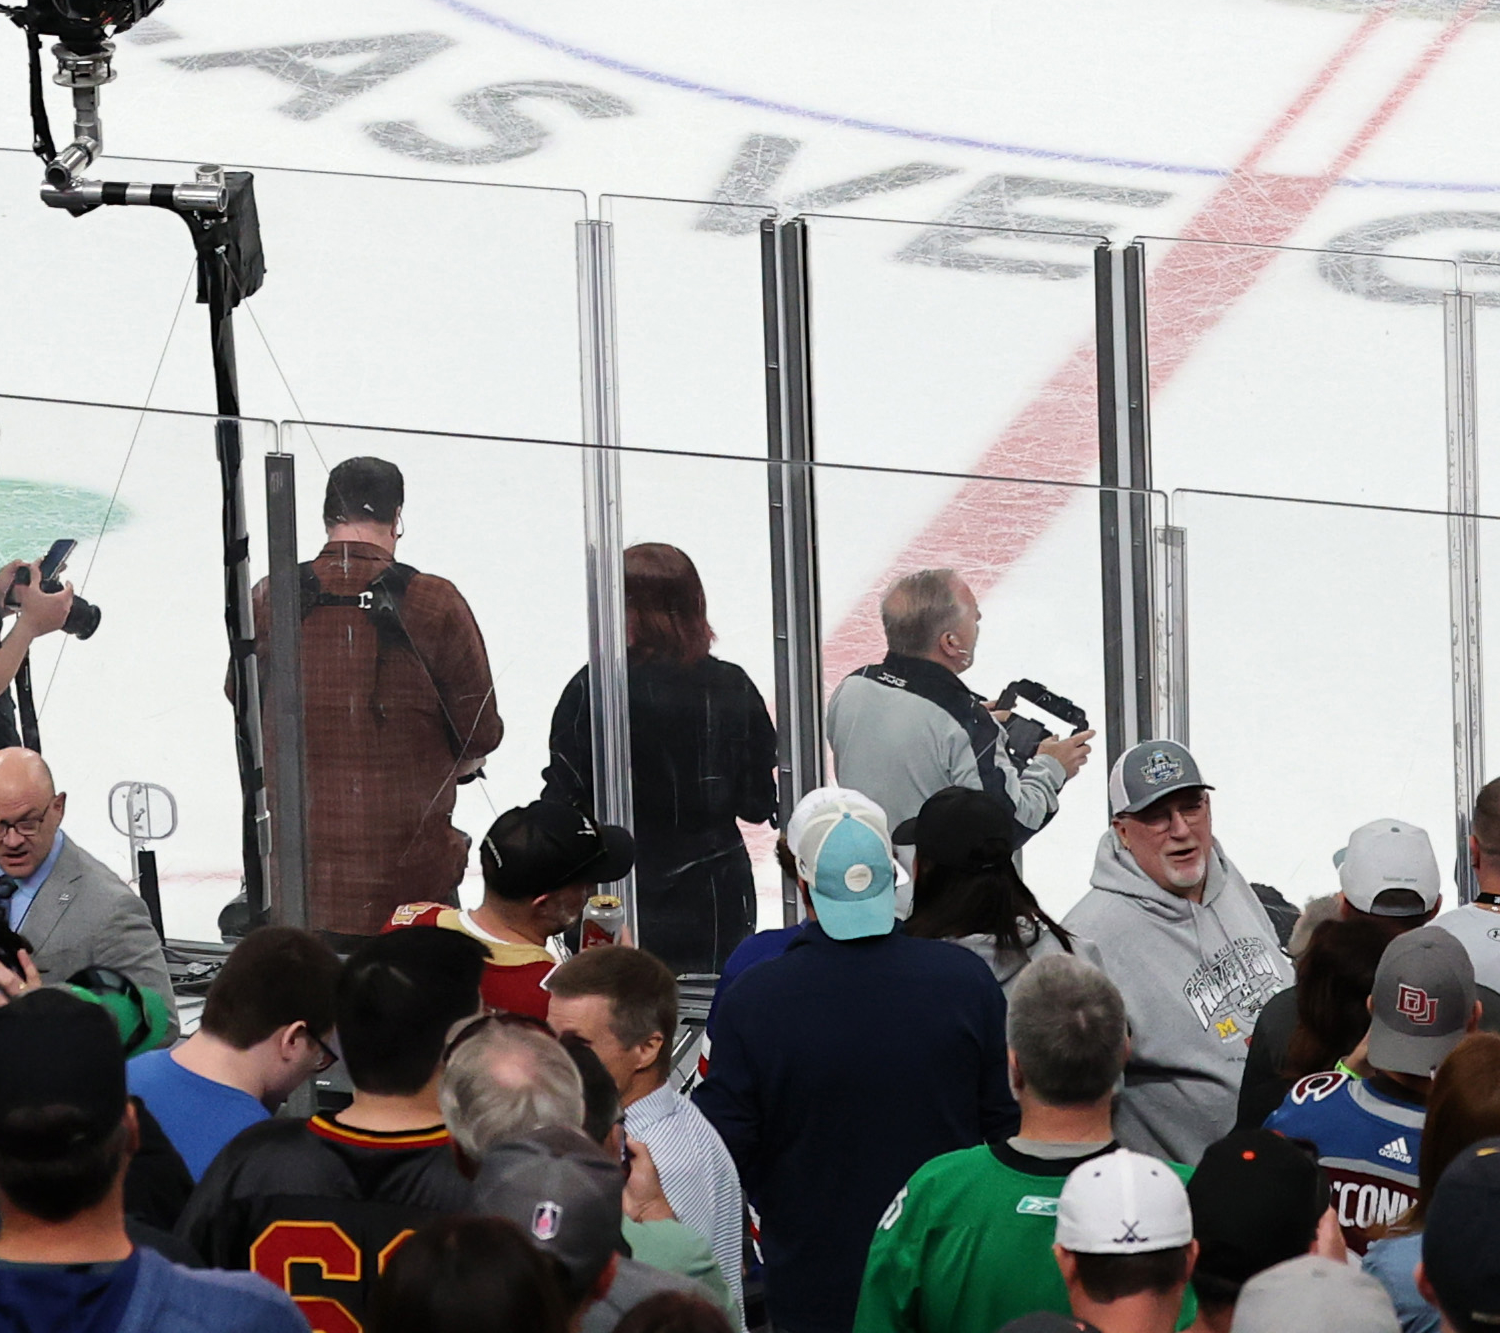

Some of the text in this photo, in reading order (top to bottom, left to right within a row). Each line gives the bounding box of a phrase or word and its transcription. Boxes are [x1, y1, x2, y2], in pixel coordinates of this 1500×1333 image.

[1396, 984, 1438, 1026] DU
[1214, 1017, 1238, 1038] M
[1378, 1145, 1412, 1165] adidas
